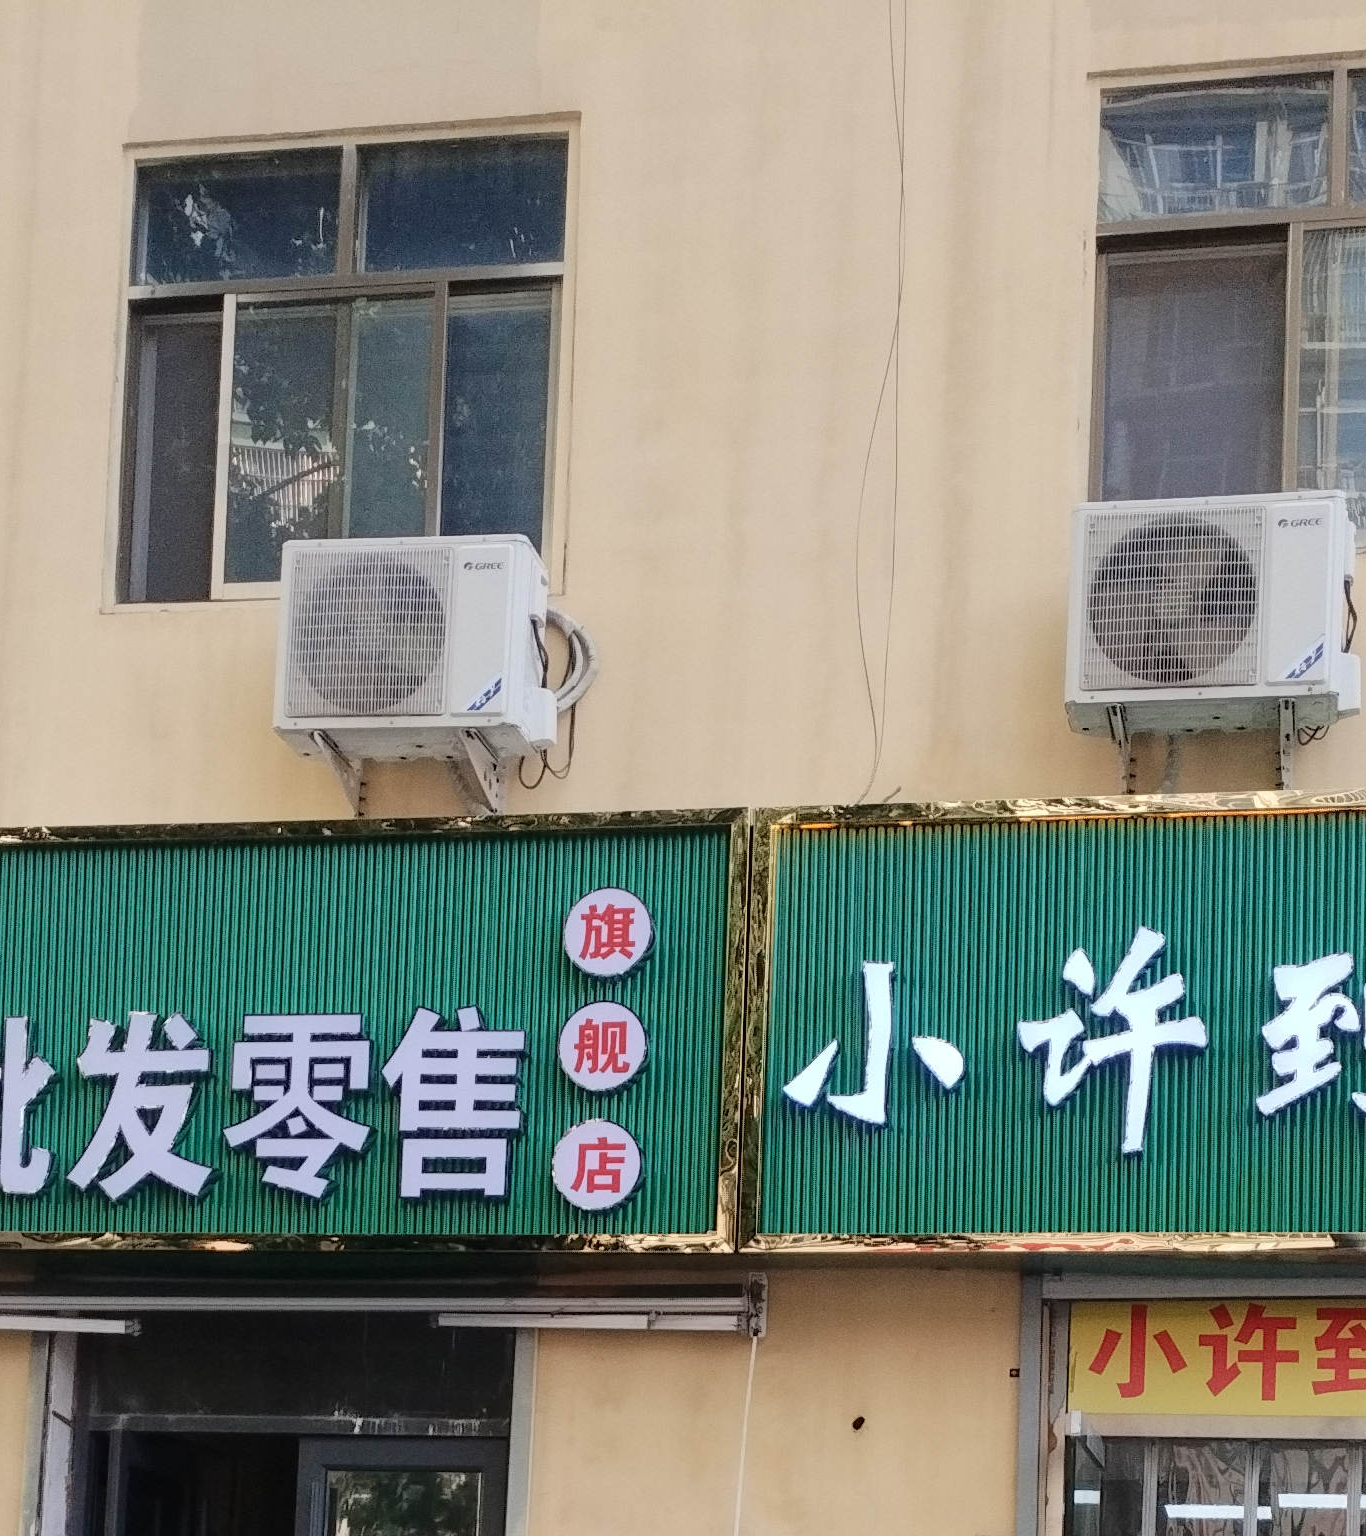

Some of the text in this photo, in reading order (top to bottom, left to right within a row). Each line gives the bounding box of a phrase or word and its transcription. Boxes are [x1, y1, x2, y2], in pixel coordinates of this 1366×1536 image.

[1290, 518, 1323, 527] GREE
[475, 562, 504, 570] GREE
[570, 904, 636, 1194] 旗舰店
